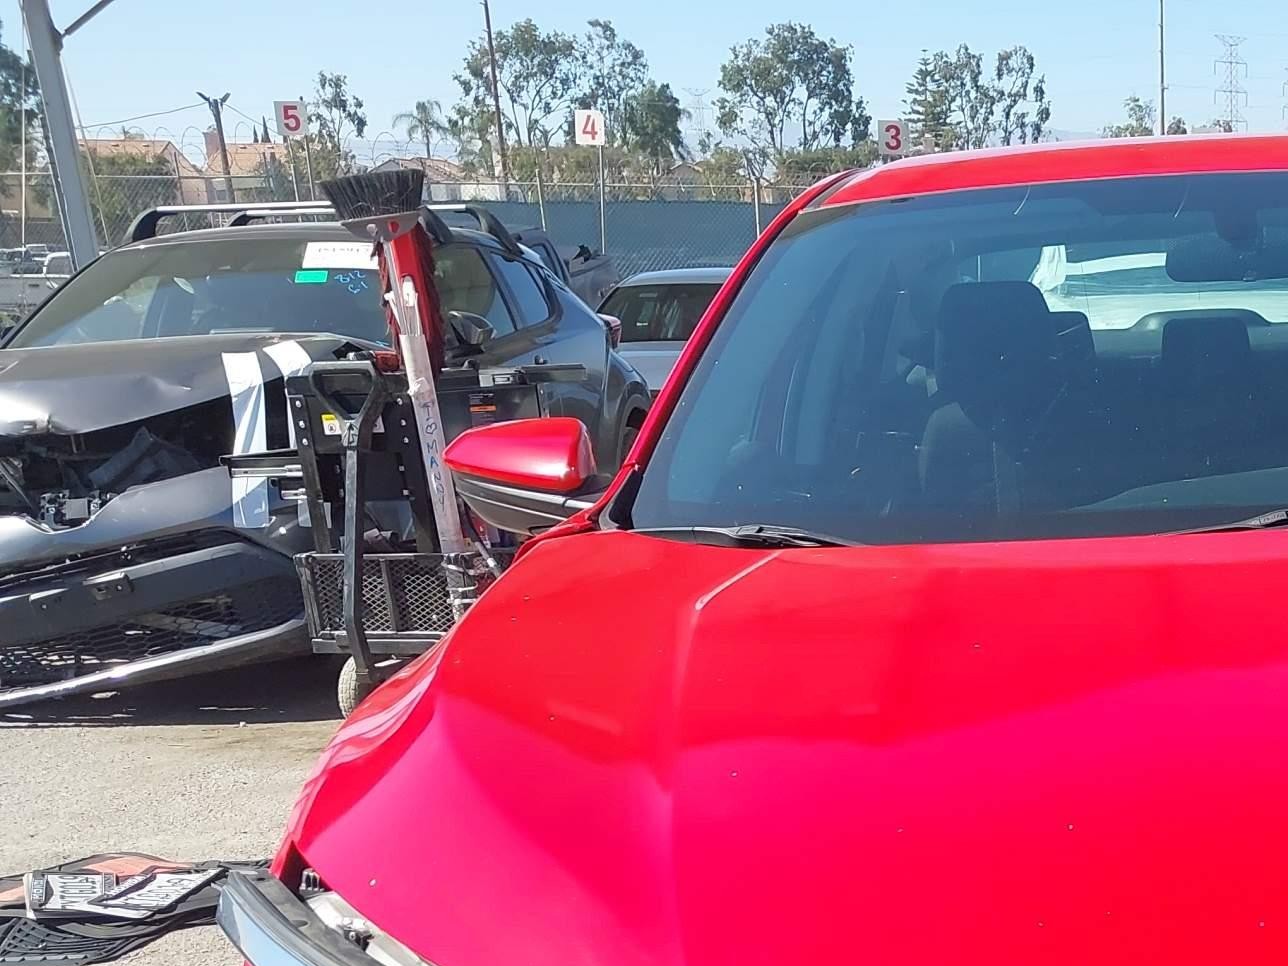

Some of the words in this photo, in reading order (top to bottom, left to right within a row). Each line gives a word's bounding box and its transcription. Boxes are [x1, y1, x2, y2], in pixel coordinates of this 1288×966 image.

[283, 105, 301, 131] 5
[582, 115, 598, 140] 4
[885, 124, 901, 150] 3
